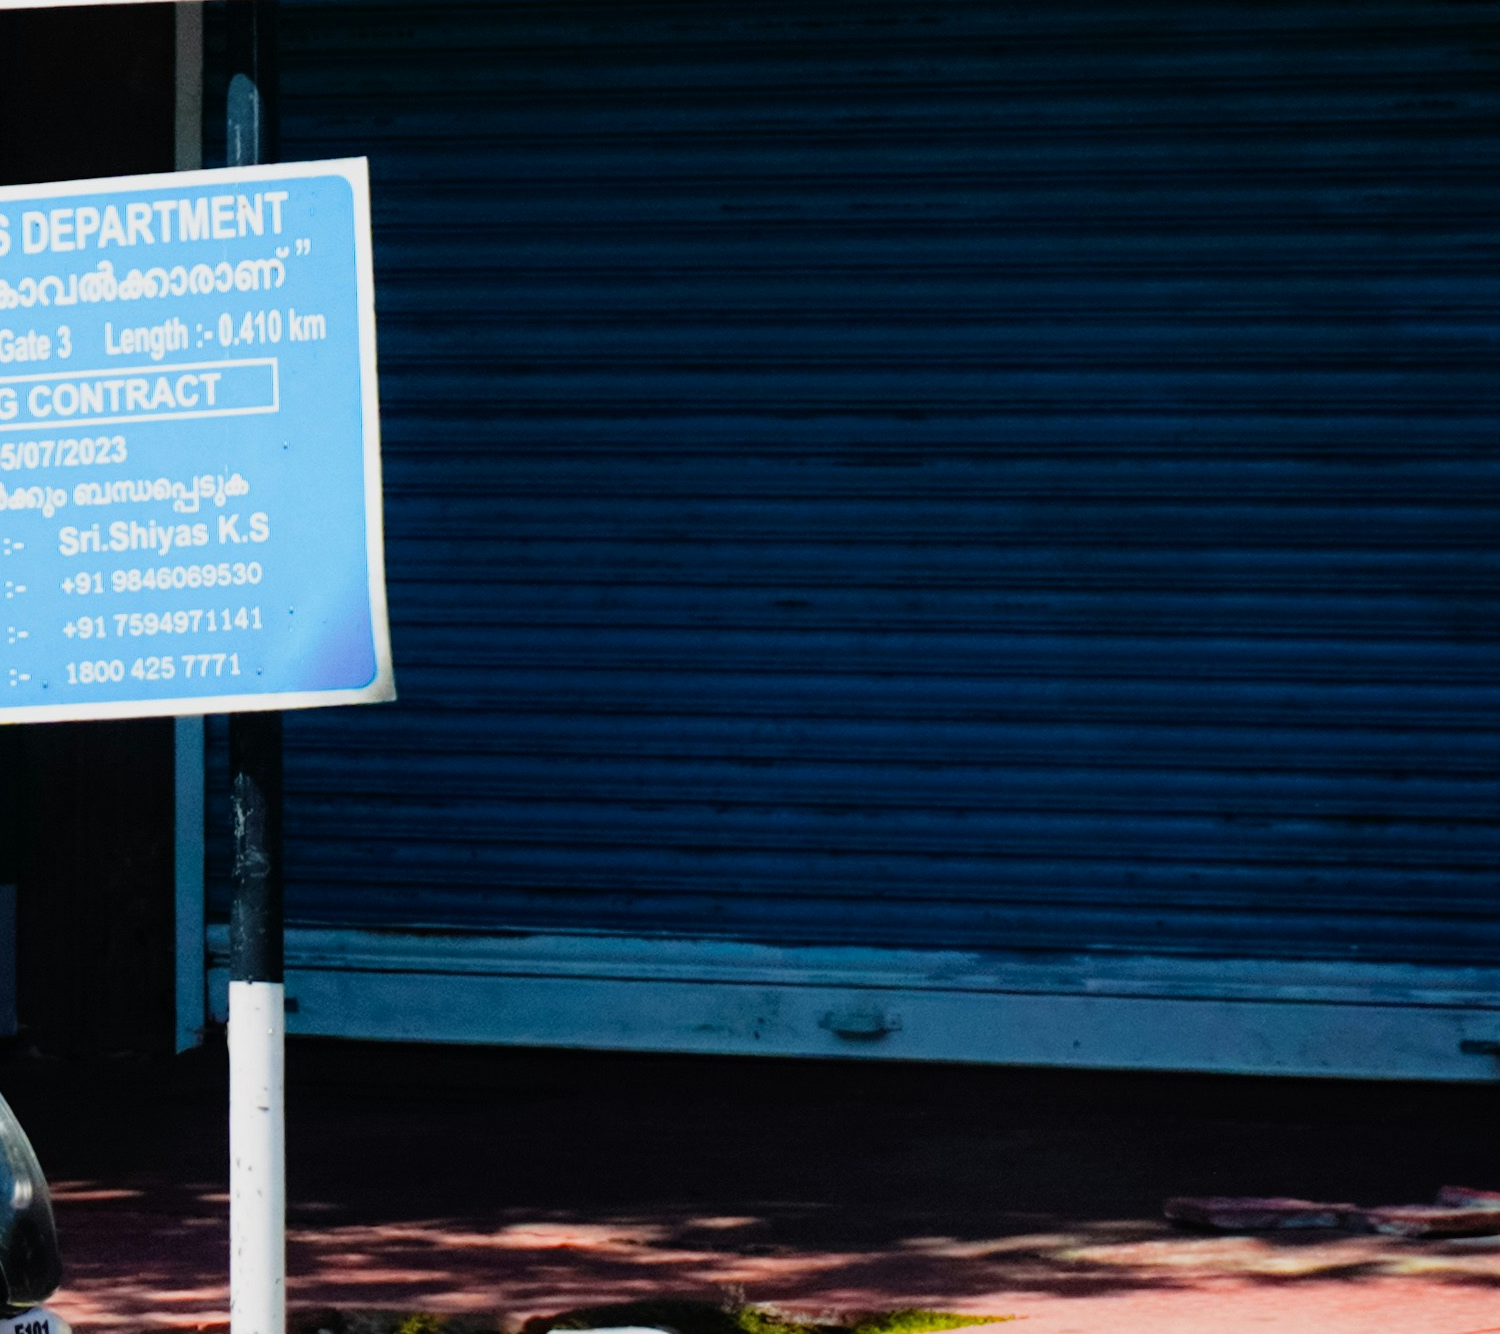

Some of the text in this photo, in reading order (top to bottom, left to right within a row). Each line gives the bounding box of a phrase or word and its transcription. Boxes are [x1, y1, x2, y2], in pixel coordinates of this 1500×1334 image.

[23, 192, 288, 254] DEPARTMENT
[57, 326, 72, 358] 3
[105, 318, 188, 360] Length
[219, 310, 282, 346] 0.410
[289, 309, 325, 341] km
[29, 373, 222, 420] CONTRACT
[59, 520, 208, 556] Sri.Shiyas
[218, 512, 269, 544] K.S
[62, 572, 103, 594] +91
[112, 562, 262, 592] 9846069530
[63, 616, 105, 639] +91
[114, 607, 262, 636] 7594971141
[67, 660, 124, 684] 1800
[131, 656, 175, 680] 425
[182, 653, 240, 677] 7771
